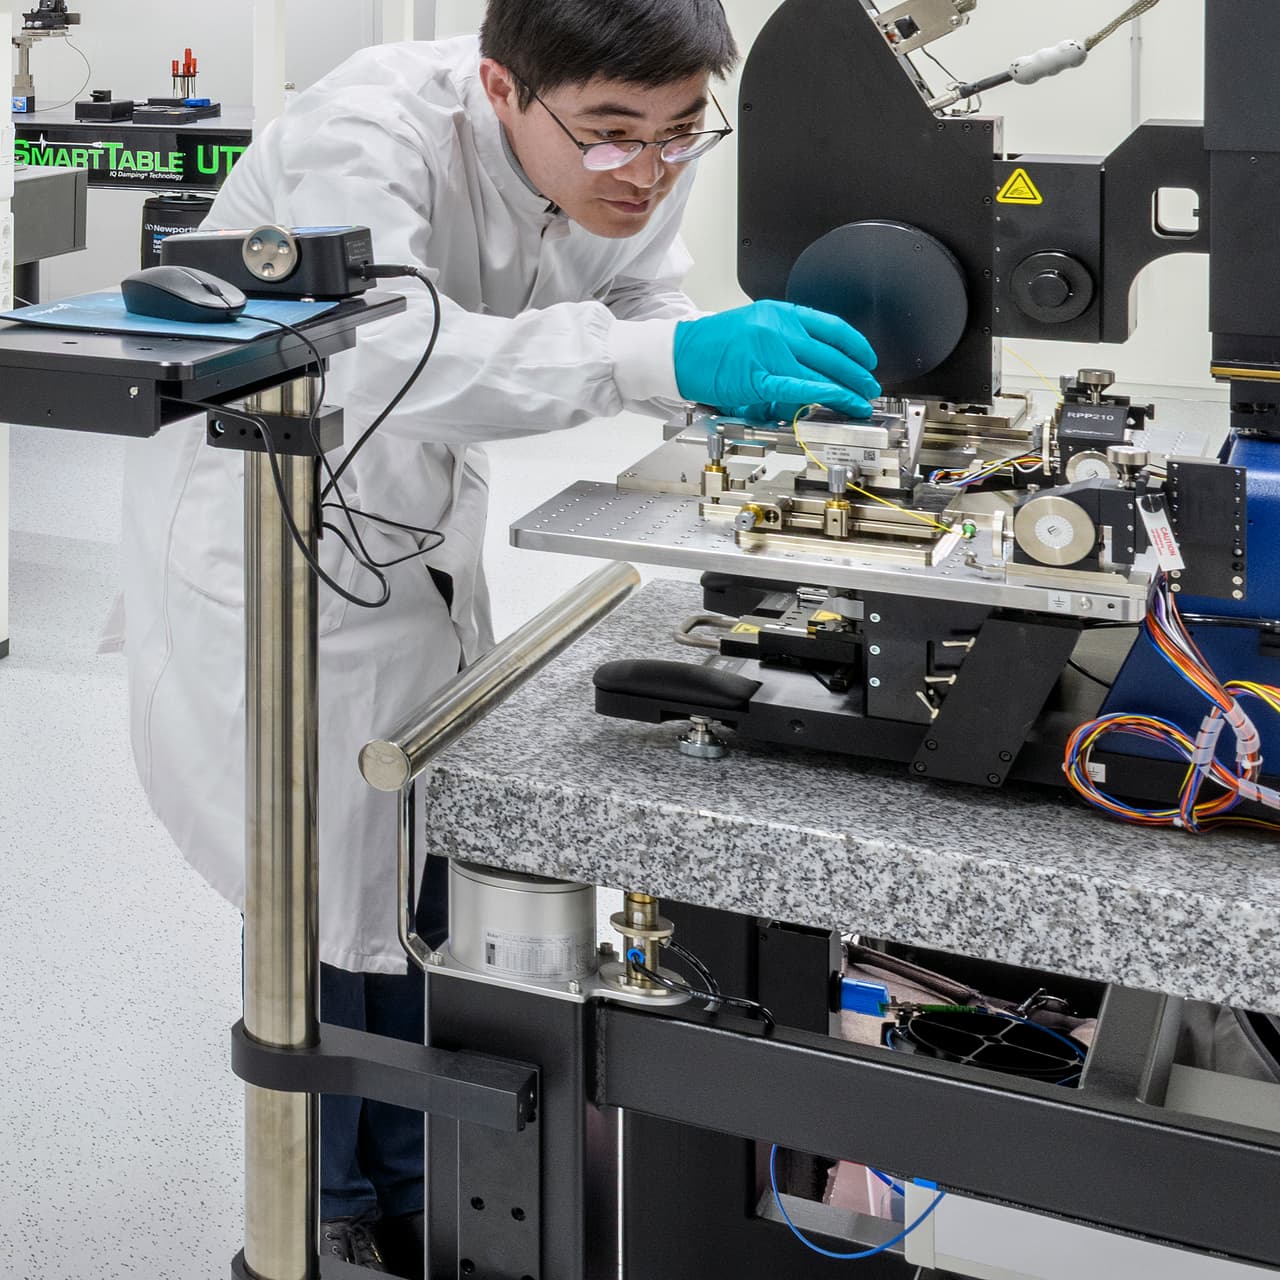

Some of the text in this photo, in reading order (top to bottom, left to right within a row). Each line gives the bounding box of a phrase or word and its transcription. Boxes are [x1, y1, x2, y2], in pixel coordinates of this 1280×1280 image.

[197, 144, 249, 176] UT
[149, 172, 184, 181] Technology
[1067, 411, 1115, 421] RPP210
[1160, 526, 1177, 557] CAUTION
